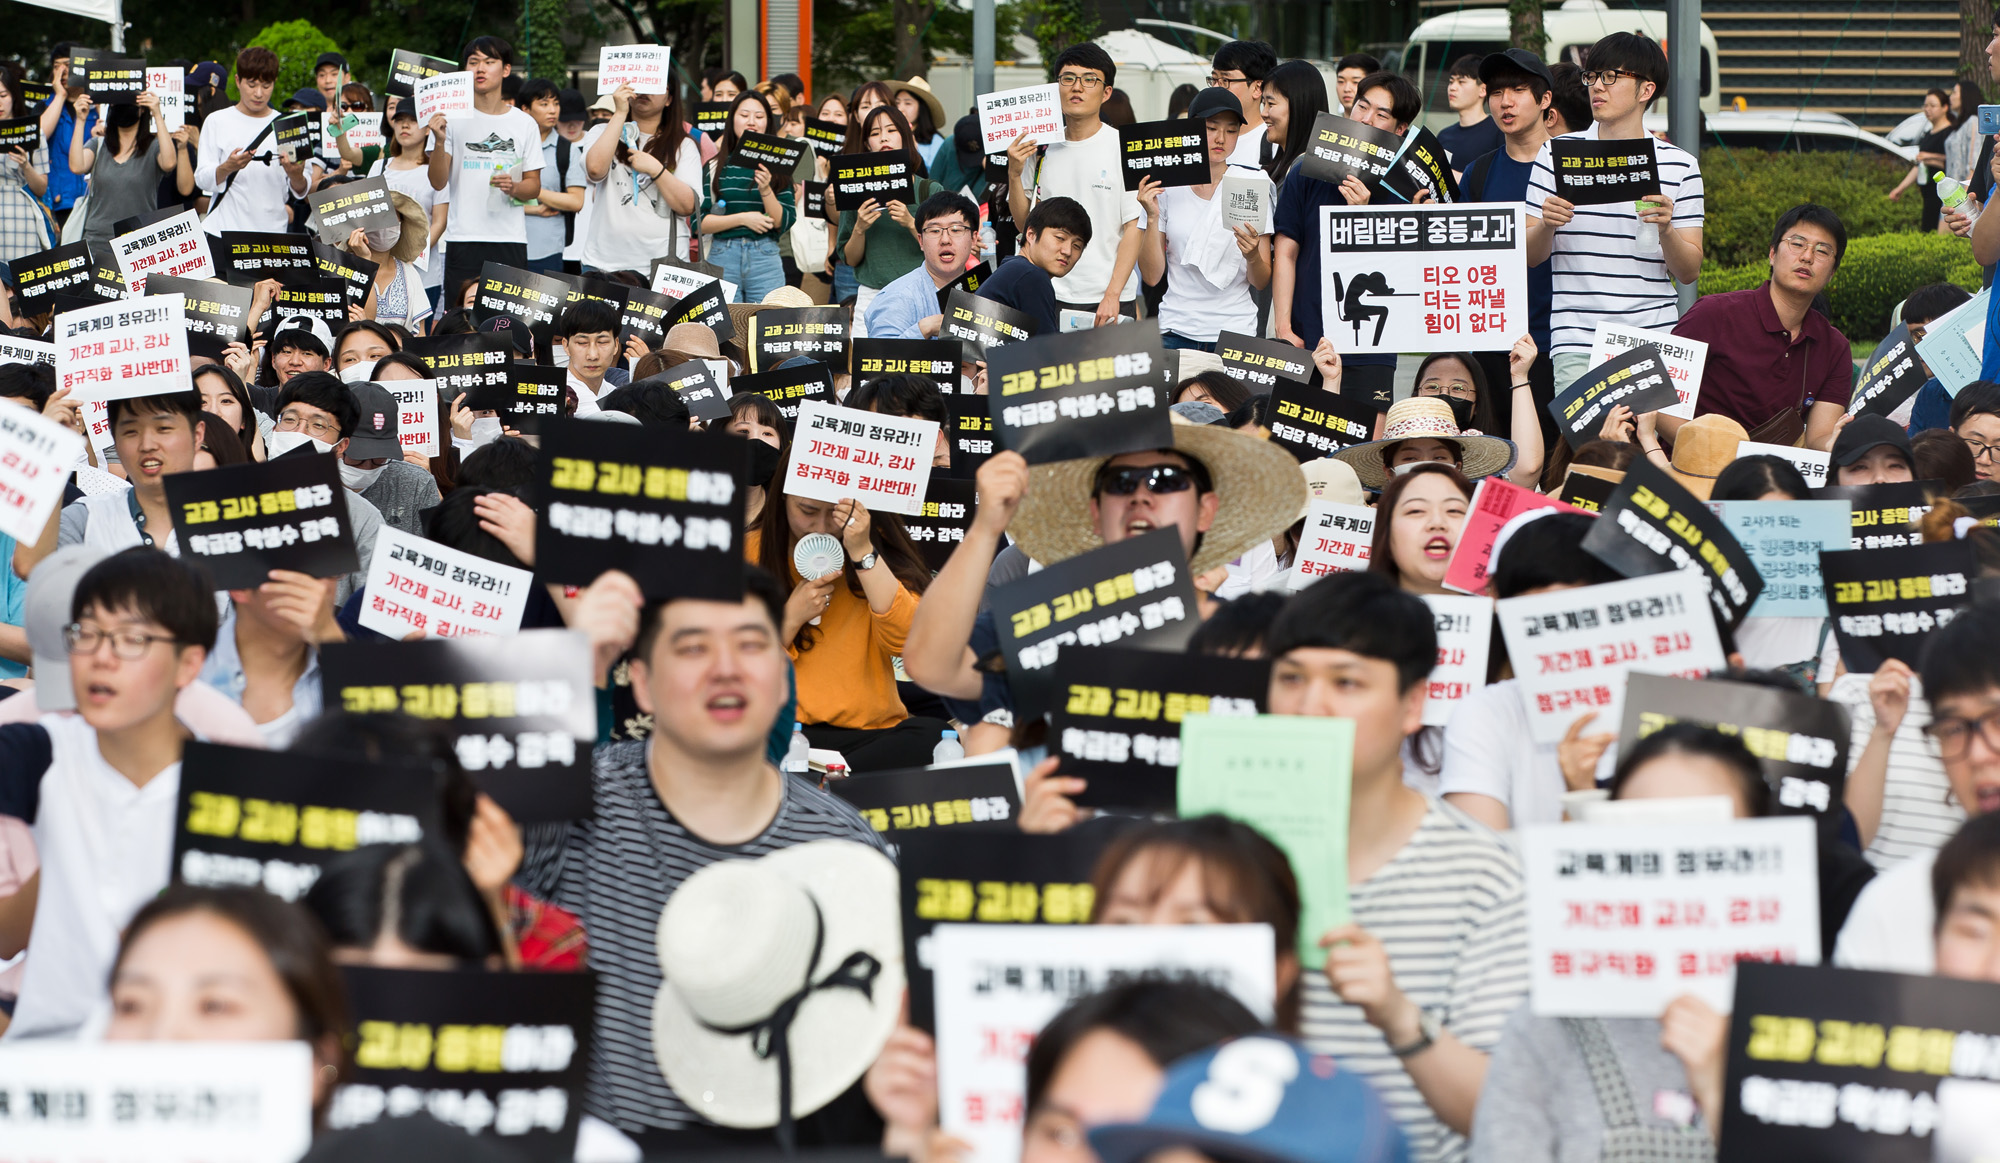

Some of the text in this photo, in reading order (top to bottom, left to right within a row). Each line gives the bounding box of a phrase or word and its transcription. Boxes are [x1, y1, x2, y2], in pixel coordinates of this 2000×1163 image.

[117, 70, 142, 78] 증원하라
[89, 82, 142, 91] 학급당 학생수 감축
[987, 92, 1050, 110] 교육계의 정유라!!
[990, 107, 1052, 125] 기간제 교사, 강사
[987, 128, 1020, 144] 정규직화
[1127, 135, 1201, 152] 교과 교사 증원하라
[1318, 129, 1396, 162] 교과 교사 증원하라
[739, 148, 795, 166] 학급당 학생수 감축
[744, 140, 799, 157] 교과 교사 증원하라
[1314, 146, 1368, 167] 학급당 학생수
[839, 164, 906, 178] 교과 교사 증원하라
[1128, 153, 1202, 169] 학급당 학생수 감축
[1562, 155, 1648, 167] 교과 교사 증원하라
[840, 178, 907, 193] 학급당 학생수 감축
[1563, 171, 1650, 186] 학급당 학생수 감축
[319, 202, 335, 214] 교과
[122, 221, 192, 255] 교육계의 정유라!!
[1332, 215, 1514, 244] 버림받은 중등교과
[130, 239, 197, 272] 기간제 교사, 강사
[232, 245, 307, 254] 교과 교사 증원하라
[19, 256, 87, 283] 교과 교사 증원하라
[233, 258, 311, 269] 학급당 학생수 감축
[22, 271, 89, 297] 학급당 학생수 감축
[1424, 265, 1497, 286] 티오 0명
[485, 279, 558, 308] 교과 교사 증원하라
[1425, 289, 1505, 310] 더는 짜낼
[482, 296, 553, 324] 학급당 학생수 감축
[953, 307, 993, 328] 교과 교사
[67, 308, 169, 337] 교육계의 정유라!!
[764, 323, 843, 336] 교과 교사 증원하라
[949, 324, 979, 341] 학급당
[1425, 312, 1506, 333] 힘이 없다
[70, 333, 170, 361] 기간제 교사, 강사
[764, 340, 842, 353] 학급당 학생수 감축
[438, 351, 506, 367] 교사 증원하라
[861, 359, 954, 374] 교과 교사 증원하라
[1222, 347, 1305, 374] 교과 교사 증원하라
[64, 359, 179, 388] 정규직화 결사반대!
[450, 372, 507, 387] 학생수 감축
[1002, 352, 1152, 396] 교과 교사 증원하라
[518, 383, 558, 396] 증원하라
[537, 403, 557, 414] 감축
[1564, 381, 1608, 420] 교과 교사
[960, 417, 981, 430] 교과
[1277, 400, 1367, 439] 교과 교사 증원하라
[811, 415, 921, 446] 교육계의 정유라!!
[1272, 422, 1306, 443] 학급당
[809, 440, 915, 470] 기간제 교사, 강사
[797, 463, 916, 496] 정규직화 결사반대!
[184, 484, 332, 524] 교과 교사 증원하라
[1741, 516, 1800, 528] 교사가 되는
[938, 527, 965, 543] 감축
[1315, 538, 1355, 556] 기간제
[390, 544, 510, 595] 교육계의 정유라!!
[386, 572, 502, 620] 기간제 교사, 강사
[1835, 580, 1897, 603] 교과 교사
[1012, 588, 1093, 637] 교과 교사
[1067, 685, 1162, 719] 교과 교사
[1191, 1036, 1300, 1134] S
